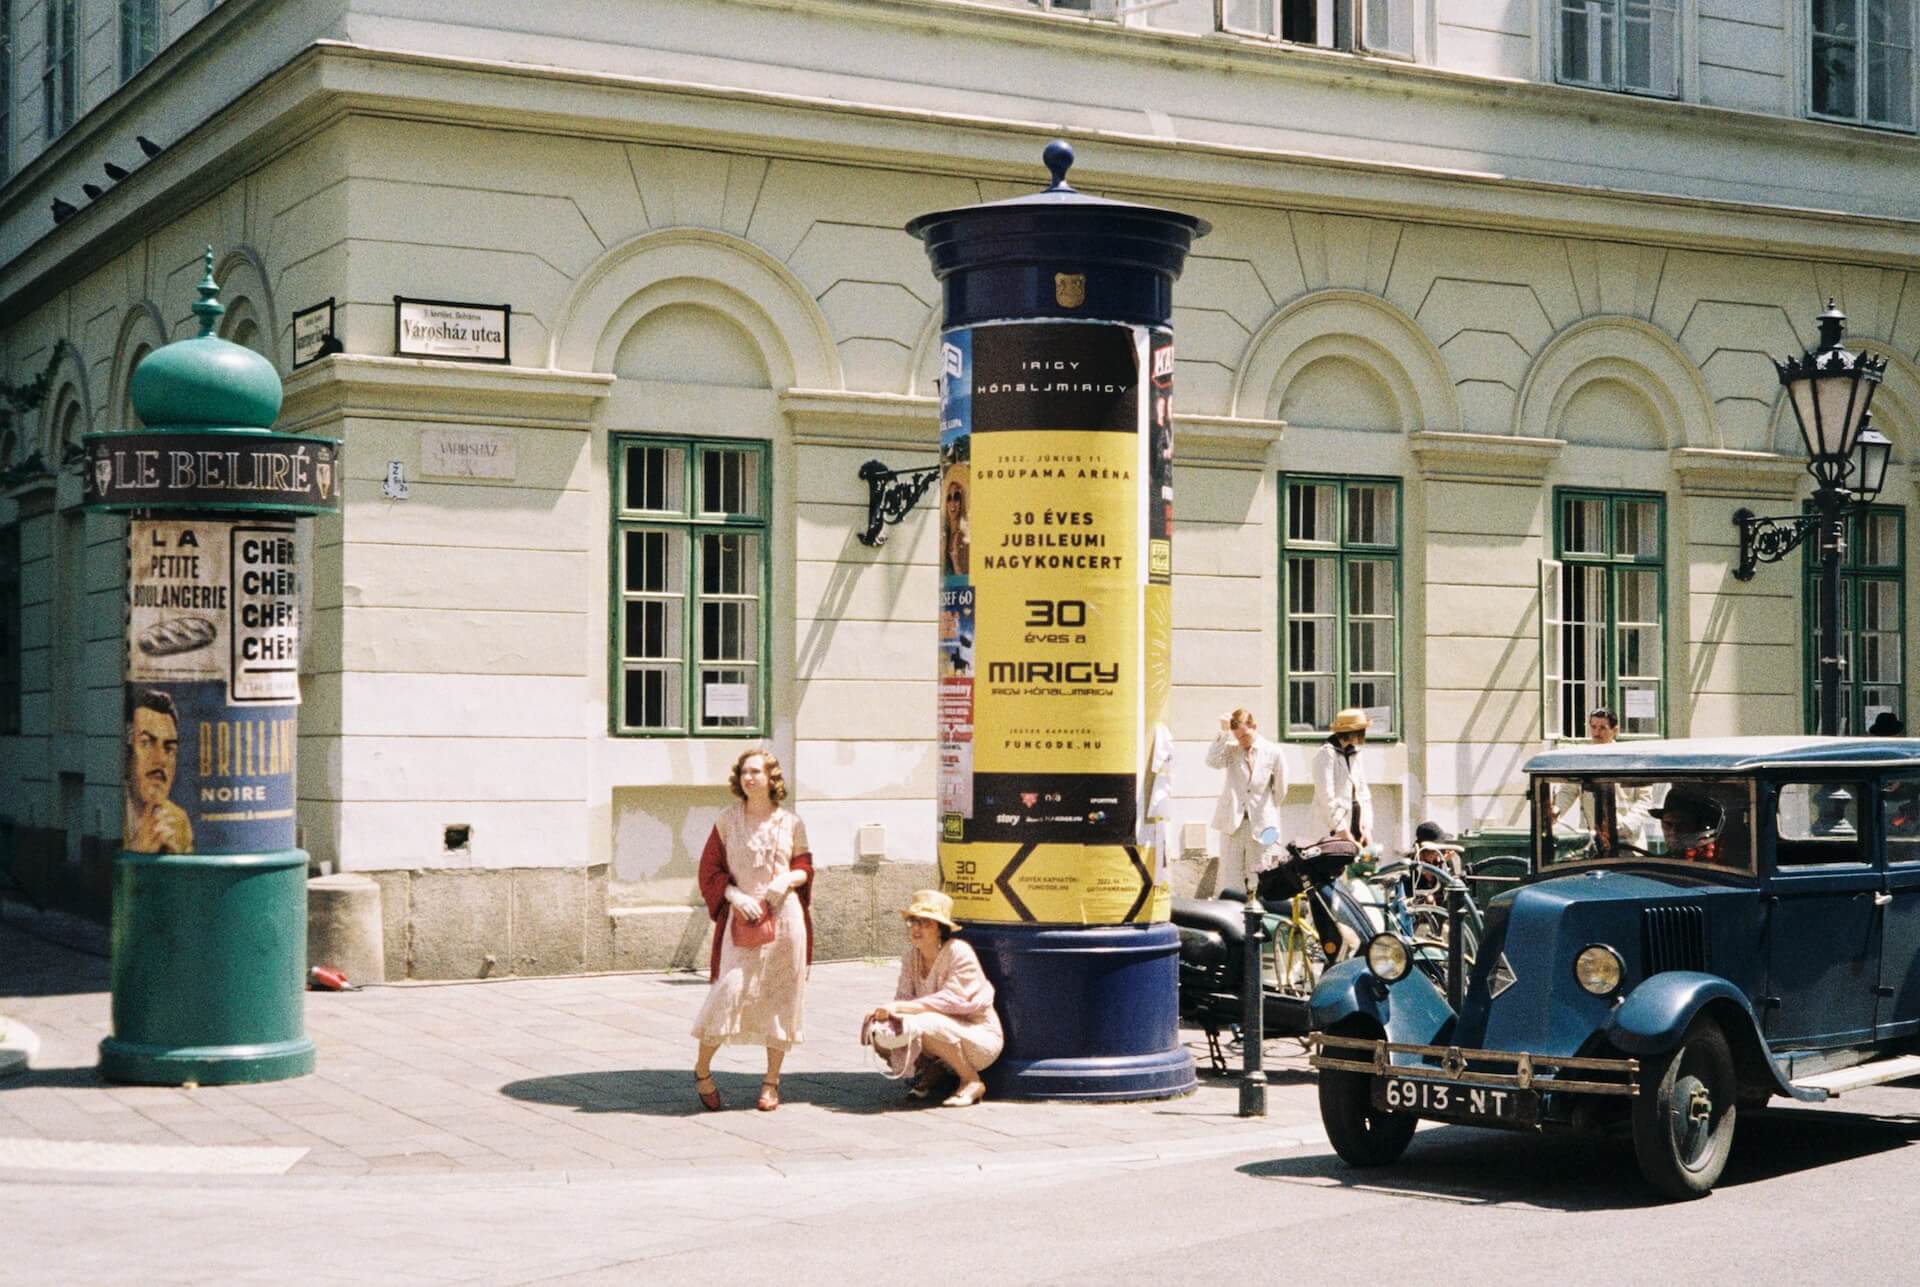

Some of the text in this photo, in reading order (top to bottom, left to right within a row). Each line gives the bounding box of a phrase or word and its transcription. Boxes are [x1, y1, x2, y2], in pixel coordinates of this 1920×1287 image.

[404, 318, 502, 344] Városház utca
[1022, 361, 1080, 370] IRIGY
[114, 450, 160, 490] LE
[168, 445, 311, 493] BELIRÉ
[977, 466, 1130, 481] GROUPAMA ARÉNA
[1013, 508, 1094, 526] 30 ÉVES
[152, 529, 199, 548] LA
[1001, 533, 1106, 547] JUBILEUMI
[151, 555, 200, 579] PETITE
[984, 555, 1123, 570] NAGYKONCERT
[134, 584, 228, 610] BOULANGERIE
[958, 590, 973, 606] 60
[1025, 600, 1086, 627] 30
[1024, 632, 1086, 644] éves a
[988, 661, 1119, 684] MIRIGY
[1004, 740, 1102, 750] FUNCODE.HU
[201, 785, 267, 802] NOIRE
[955, 860, 976, 875] 30
[1386, 1079, 1507, 1116] 6913-NT
